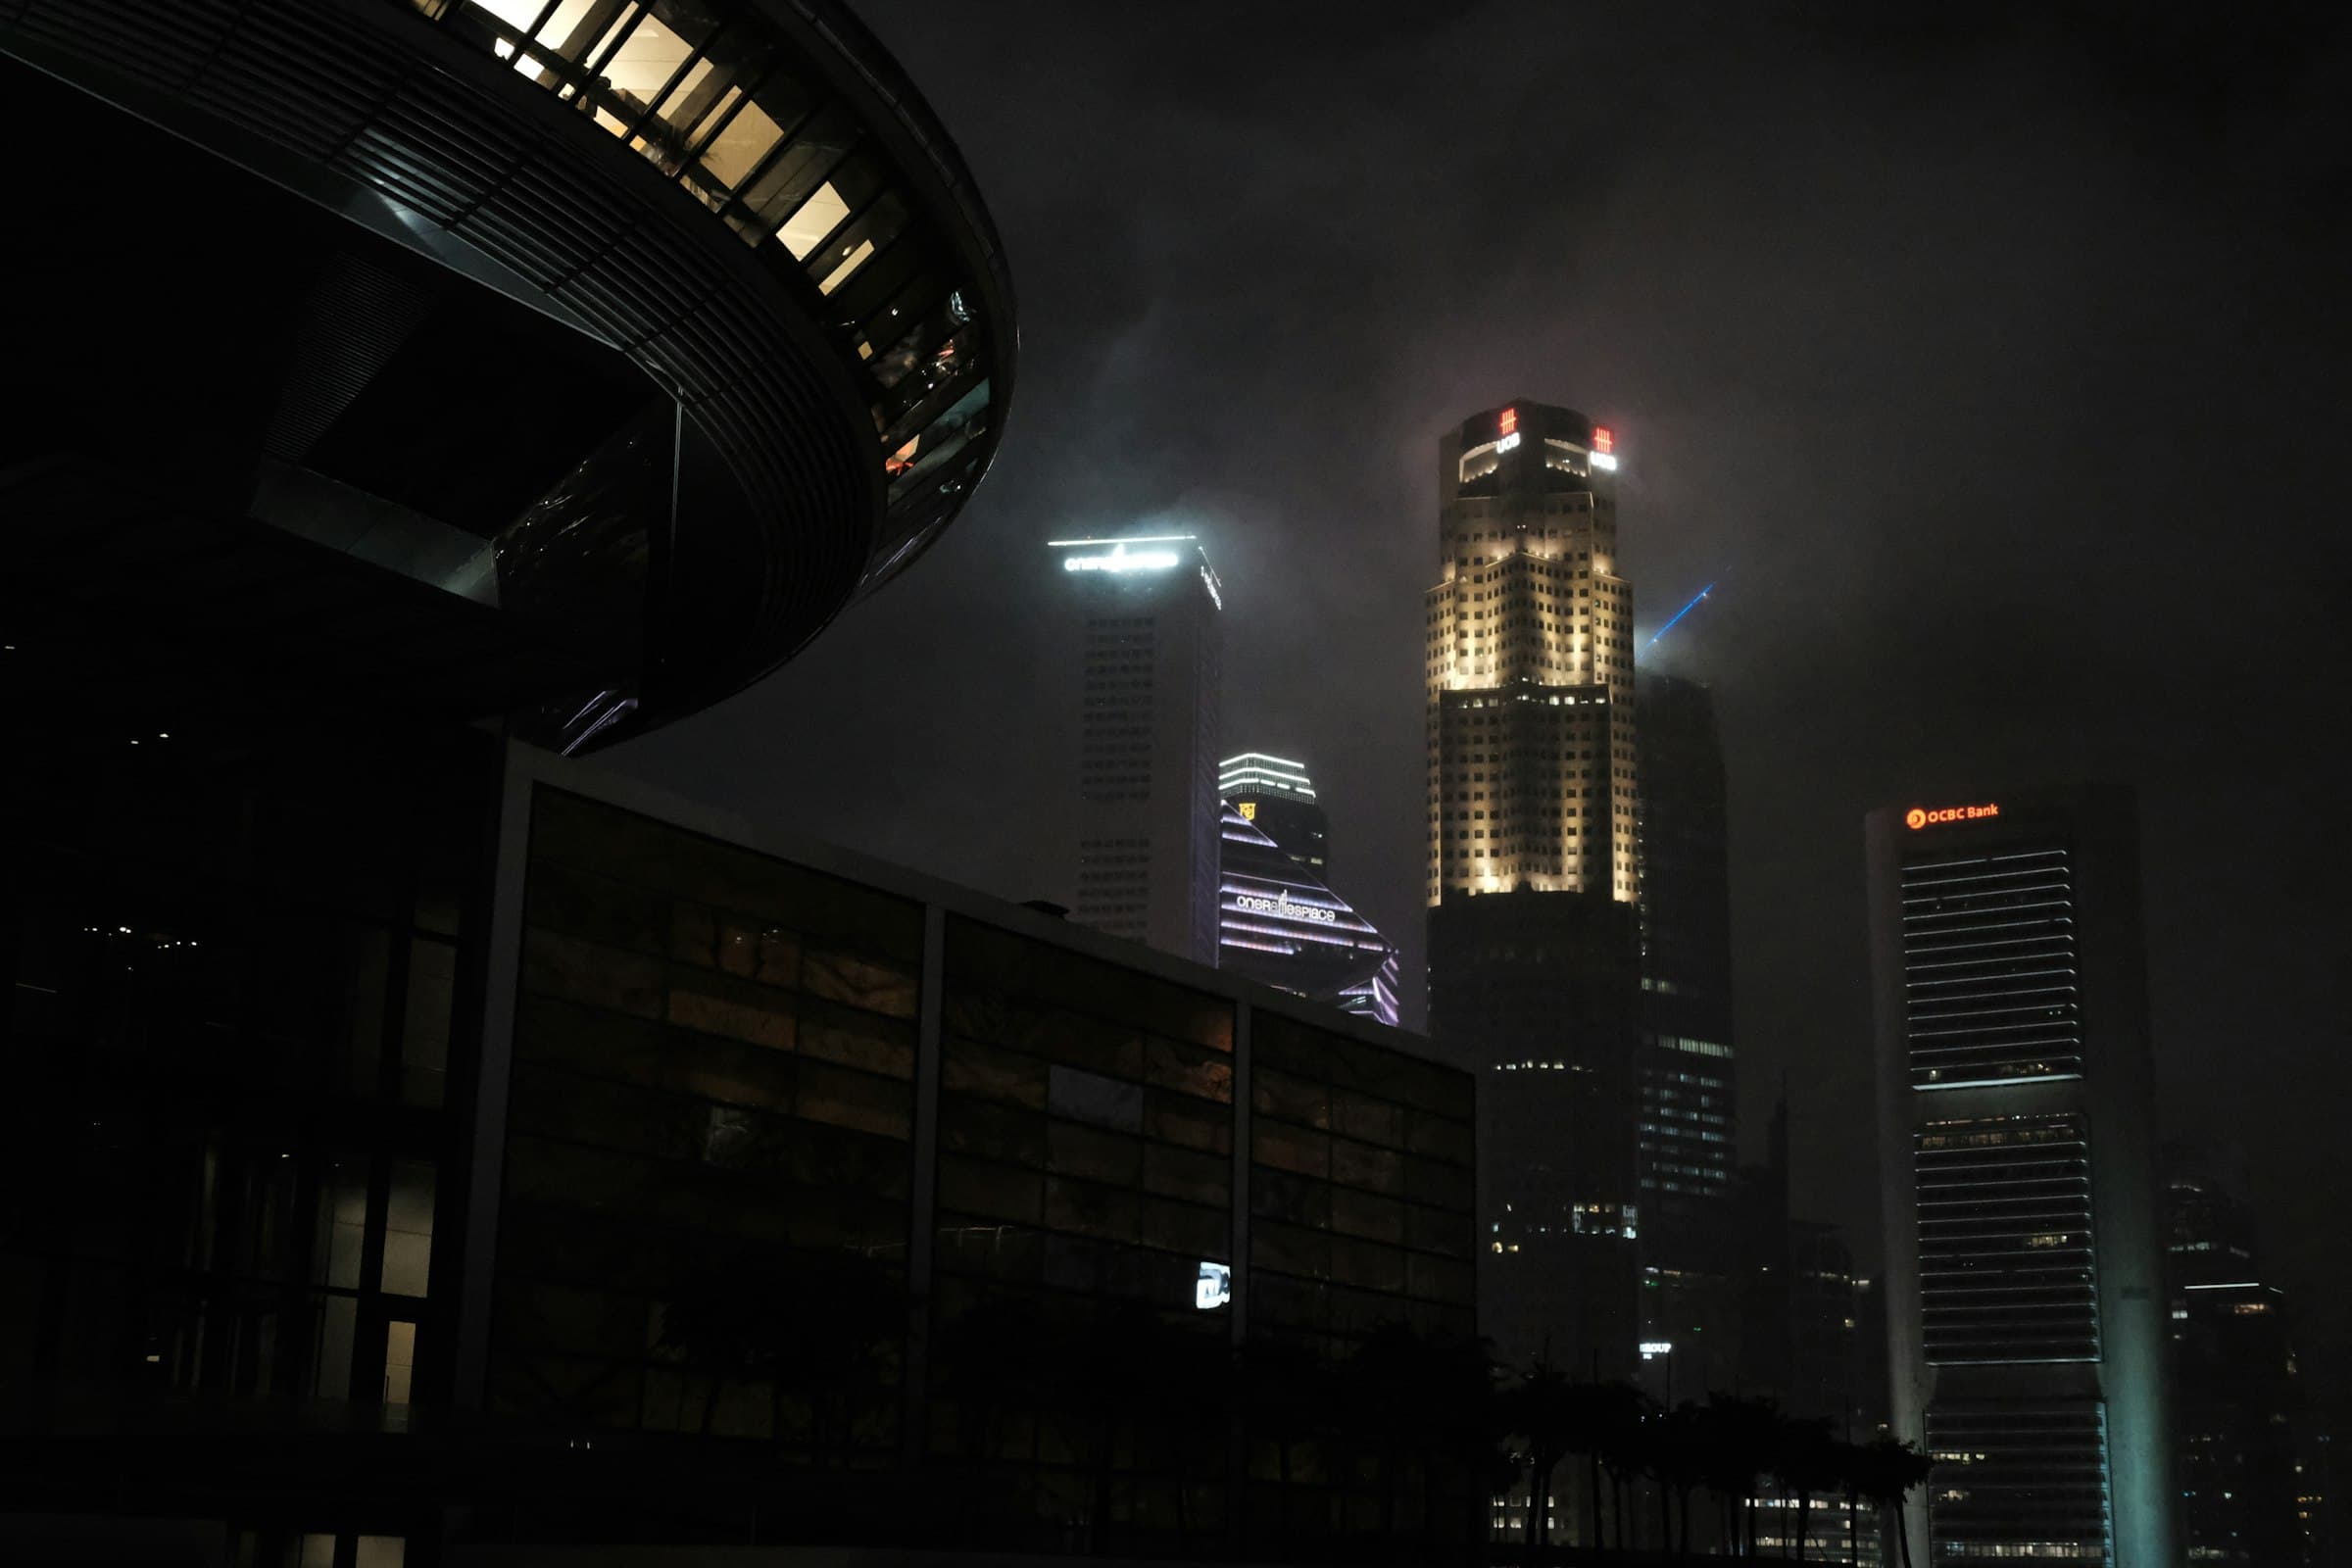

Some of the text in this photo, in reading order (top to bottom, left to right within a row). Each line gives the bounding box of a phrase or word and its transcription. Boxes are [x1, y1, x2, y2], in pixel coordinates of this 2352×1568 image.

[1496, 432, 1520, 453] UOB
[1928, 804, 1998, 823] OCBC Bank
